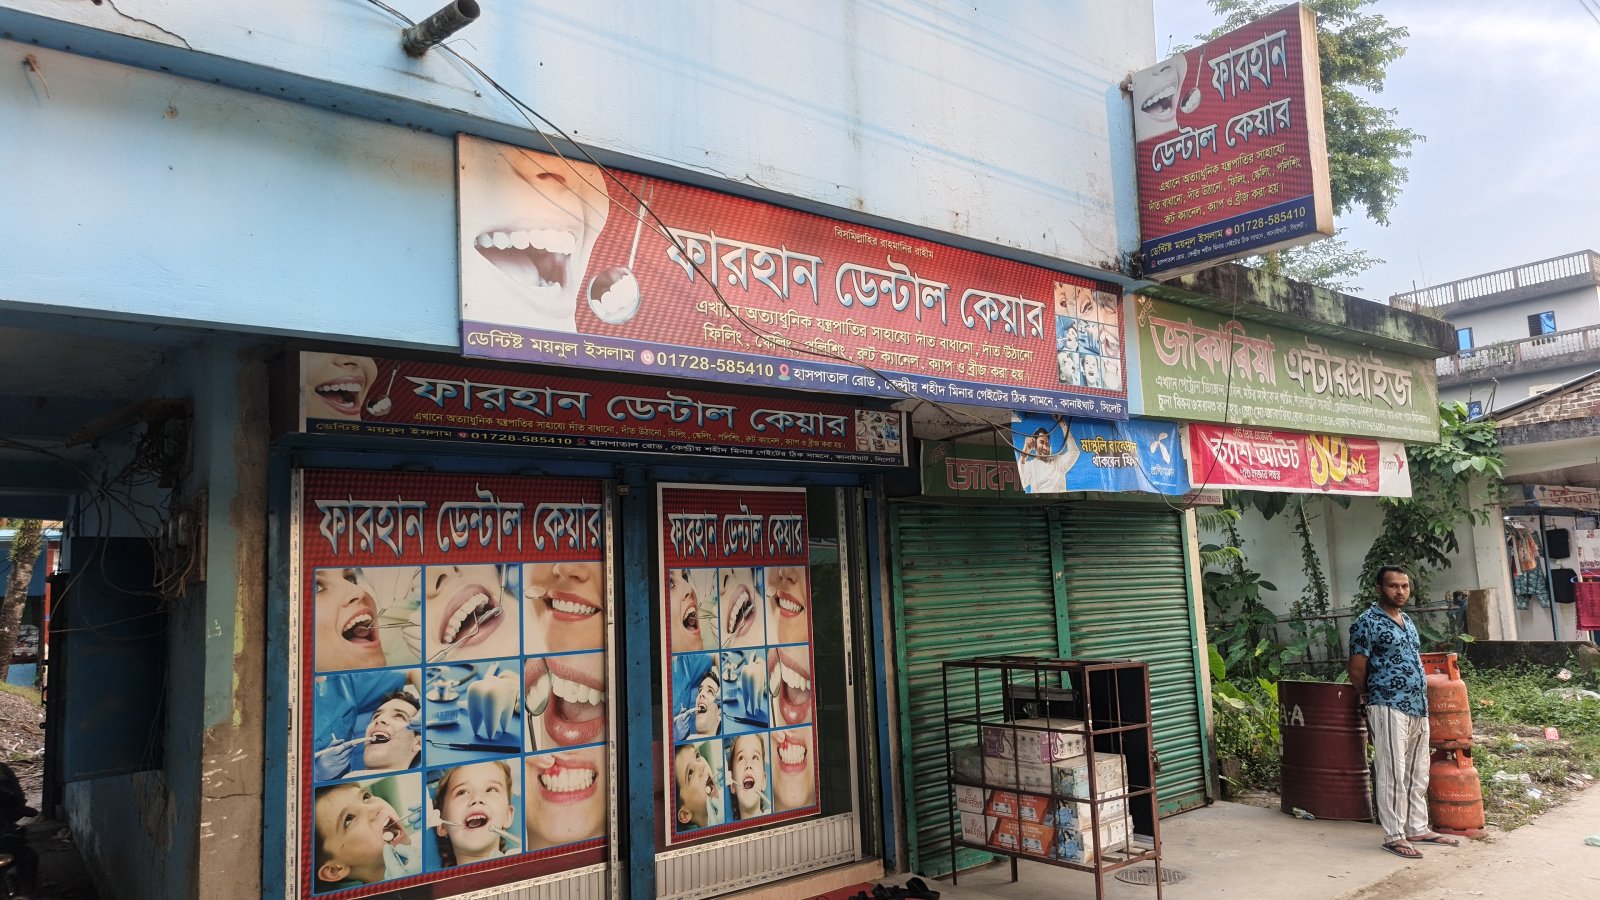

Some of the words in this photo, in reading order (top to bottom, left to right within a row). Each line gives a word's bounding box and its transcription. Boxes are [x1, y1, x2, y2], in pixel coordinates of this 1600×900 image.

[1207, 29, 1288, 100] ফারহান
[1151, 124, 1218, 172] ডেন্টাল
[1225, 97, 1292, 147] কেয়ার
[1198, 228, 1224, 243] ইসলাম
[1233, 206, 1306, 235] 01728-585410
[1226, 196, 1233, 206] ও
[658, 224, 824, 306] ফারহান
[834, 254, 951, 327] ডেন্টাল
[960, 287, 1047, 341] কেয়ার
[696, 300, 740, 319] এখানে
[745, 306, 813, 330] অত্যাধুনিক
[816, 317, 867, 339] যন্ত্রপাতির
[915, 329, 937, 349] দাঁত
[982, 340, 1001, 358] দাঁত
[1003, 343, 1034, 363] উঠানো
[856, 346, 878, 361] রুট
[928, 357, 955, 374] ক্যাপ
[956, 362, 965, 374] ও
[967, 359, 988, 378] ব্রীজ
[990, 365, 1009, 380] করা
[531, 337, 578, 359] ময়নুল
[583, 339, 635, 362] ইসলাম
[656, 352, 774, 377] 01728-585410
[793, 367, 848, 386] হাসপাতাল
[921, 380, 945, 398] শহীদ
[948, 384, 974, 400] মিনার
[976, 386, 1009, 403] গেইটের
[1011, 388, 1027, 404] ঠিক
[1148, 317, 1277, 387] জাকারিয়া
[1283, 335, 1414, 410] এন্টারপ্রাইজ
[366, 425, 405, 435] ময়নুল
[410, 427, 452, 437] ইসলাম
[471, 432, 572, 445] 01728-585410
[589, 438, 639, 449] হাসপাতাল
[403, 375, 593, 420] ফারহান
[606, 390, 738, 430] ডেন্টাল
[750, 408, 849, 438] কেয়ার
[413, 412, 443, 422] এখানে
[447, 414, 493, 427] অত্যাধুনিক
[495, 417, 533, 429] যন্ত্রপাতির
[569, 420, 585, 431] দাঁত
[621, 424, 636, 435] দাঁত
[1210, 437, 1253, 467] ক্যাশ
[1253, 438, 1300, 470] আউট
[314, 494, 429, 559] ফারহান
[435, 482, 525, 553] ডেন্টাল
[532, 498, 603, 552] কেয়ার
[667, 508, 719, 561] ফারহান
[722, 497, 764, 558] ডেন্টাল
[767, 510, 803, 557] কেয়ার
